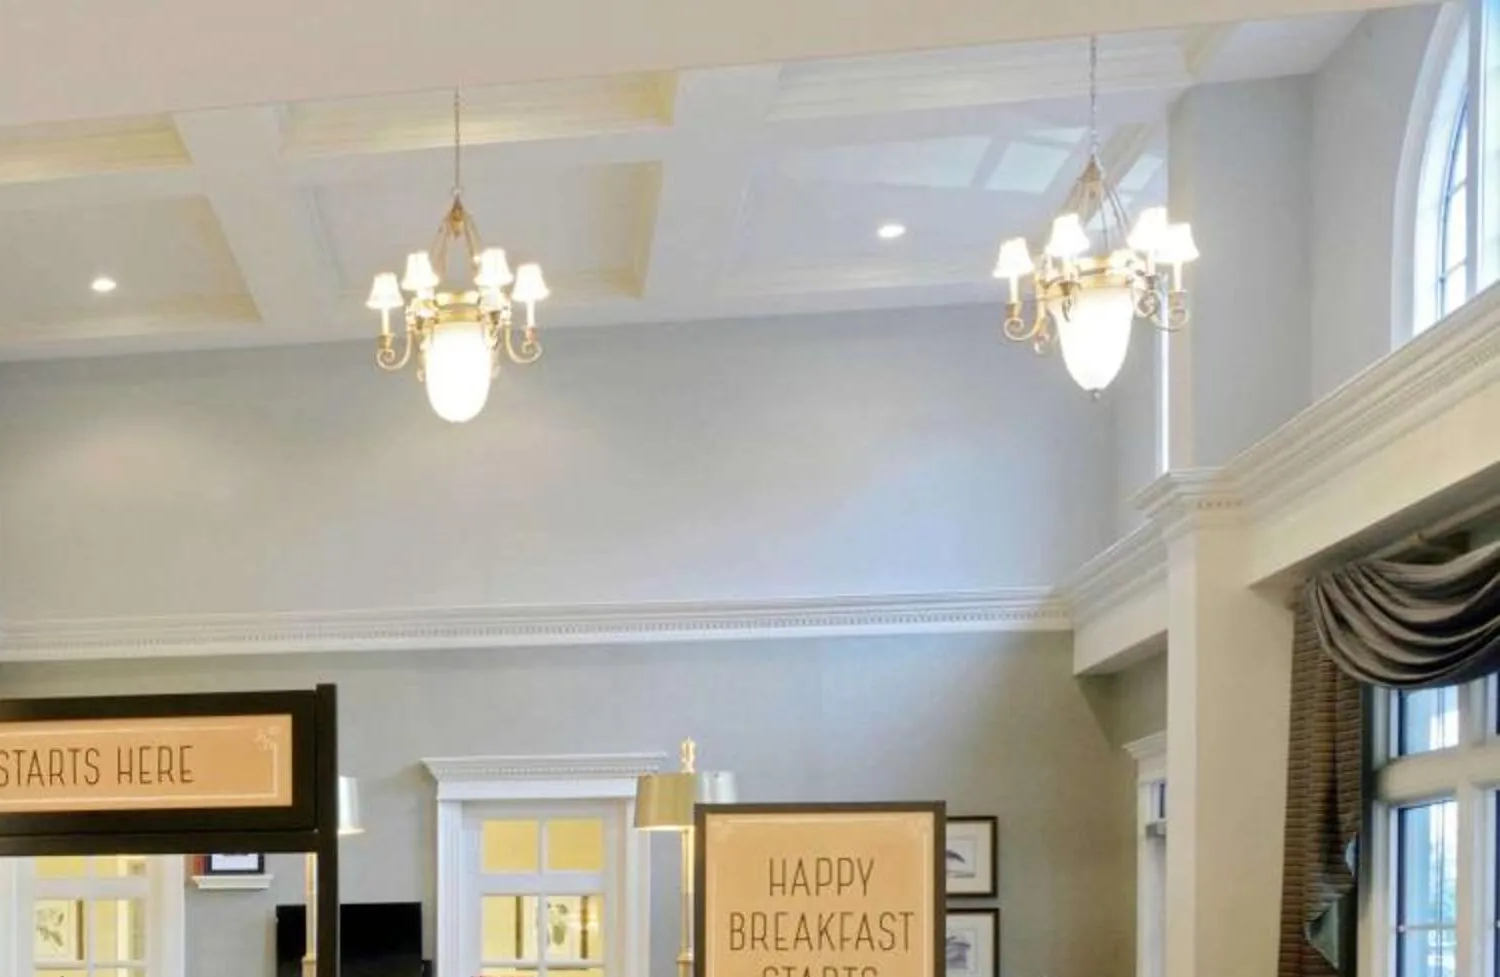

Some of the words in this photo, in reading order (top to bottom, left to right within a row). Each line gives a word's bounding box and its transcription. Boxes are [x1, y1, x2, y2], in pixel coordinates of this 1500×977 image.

[116, 745, 194, 785] HERE
[768, 857, 875, 897] HAPPY
[729, 911, 915, 951] BREAKFAST
